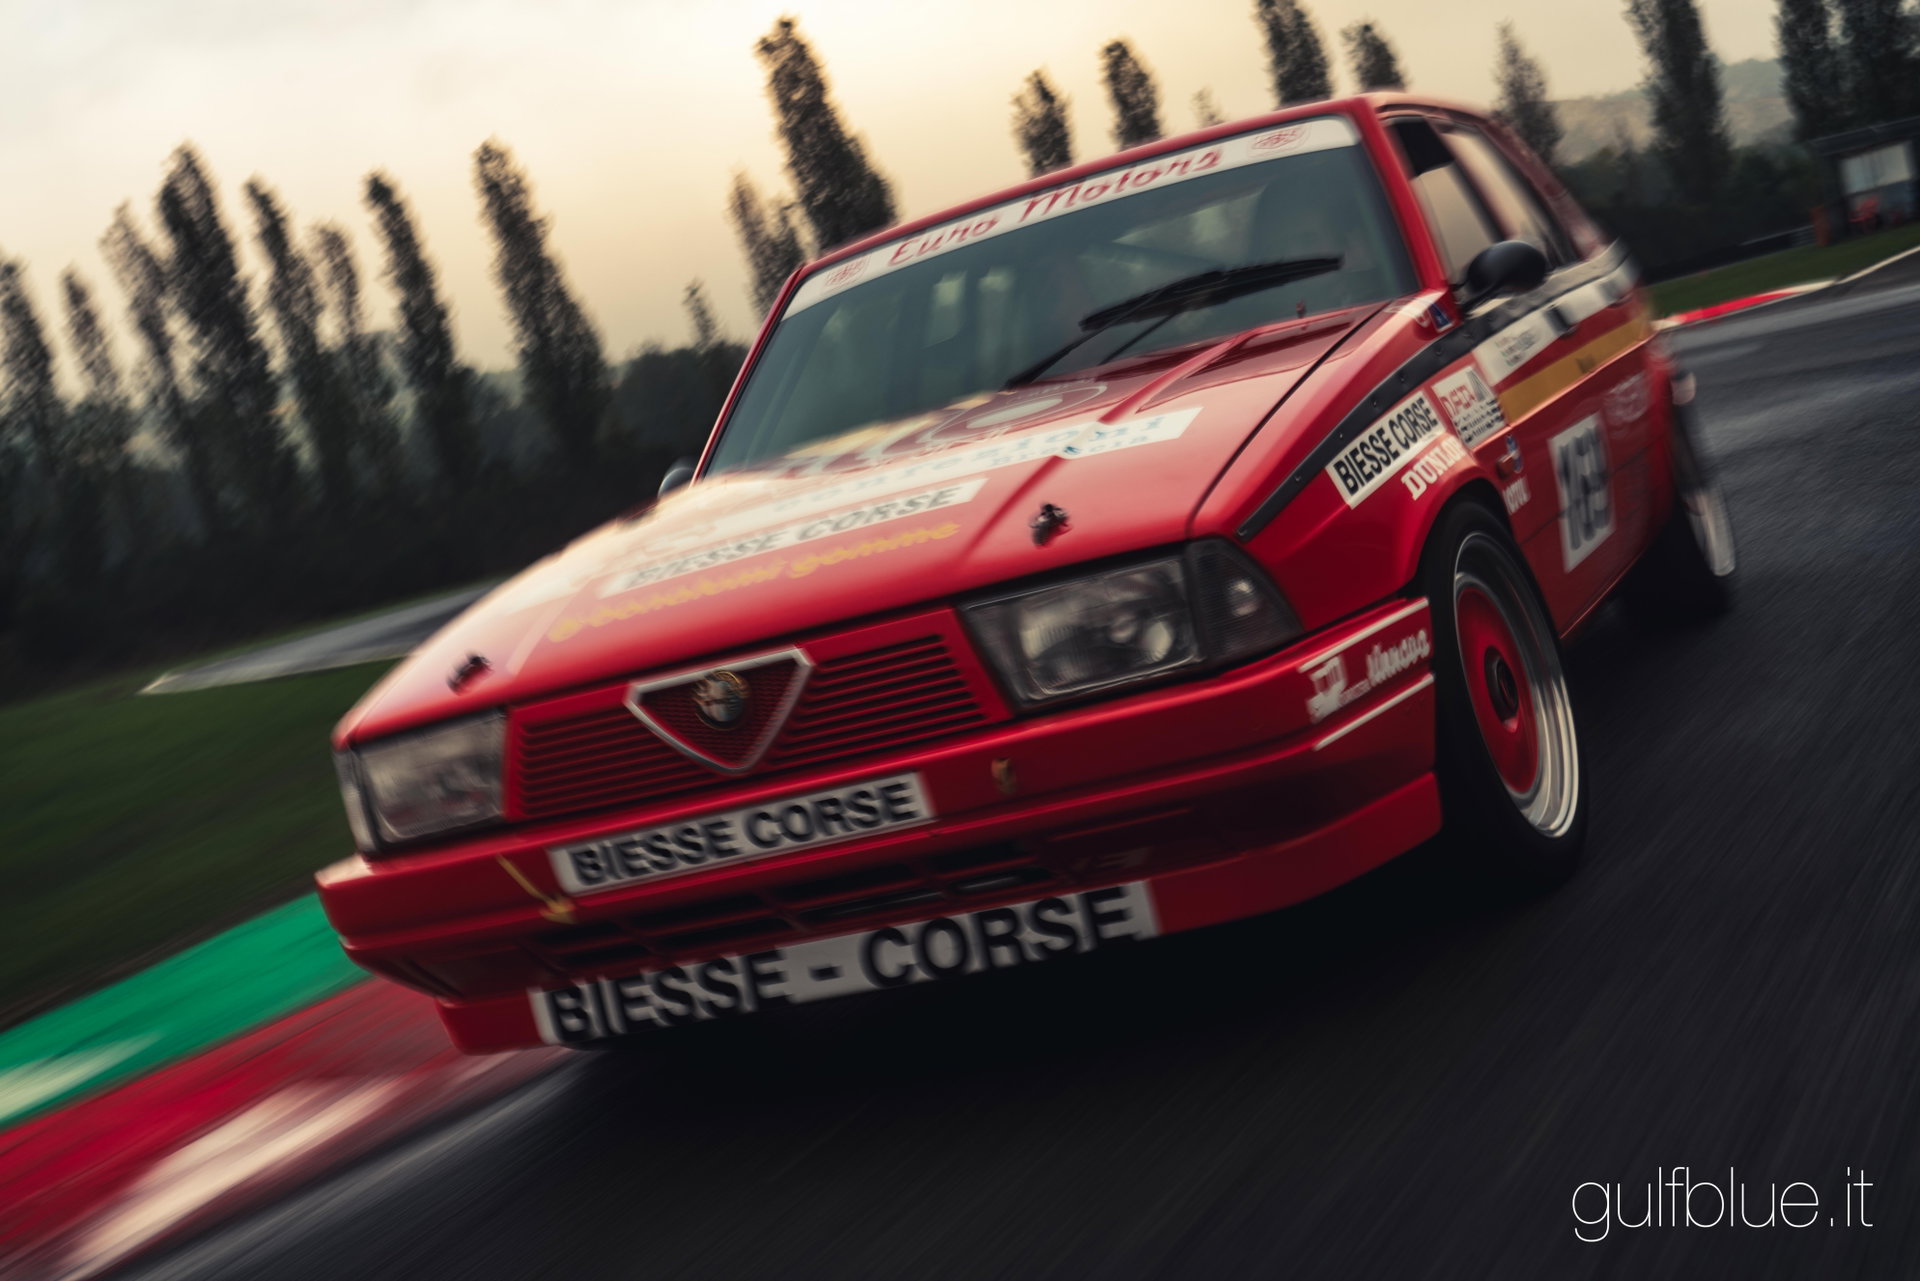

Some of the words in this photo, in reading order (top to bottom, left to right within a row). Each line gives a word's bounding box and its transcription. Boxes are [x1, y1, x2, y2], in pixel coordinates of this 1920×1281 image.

[887, 216, 1000, 267] Euro
[1018, 146, 1224, 224] Motors
[1333, 428, 1400, 494] BIESSE
[1388, 397, 1439, 451] CORSE
[1401, 436, 1465, 501] DUNLOP
[625, 530, 786, 589] BIESSE
[797, 484, 961, 542] CORSE
[568, 818, 738, 888] BIESSE
[743, 780, 919, 850] CORSE
[545, 946, 790, 1045] BIESSE
[860, 884, 1138, 989] CORSE
